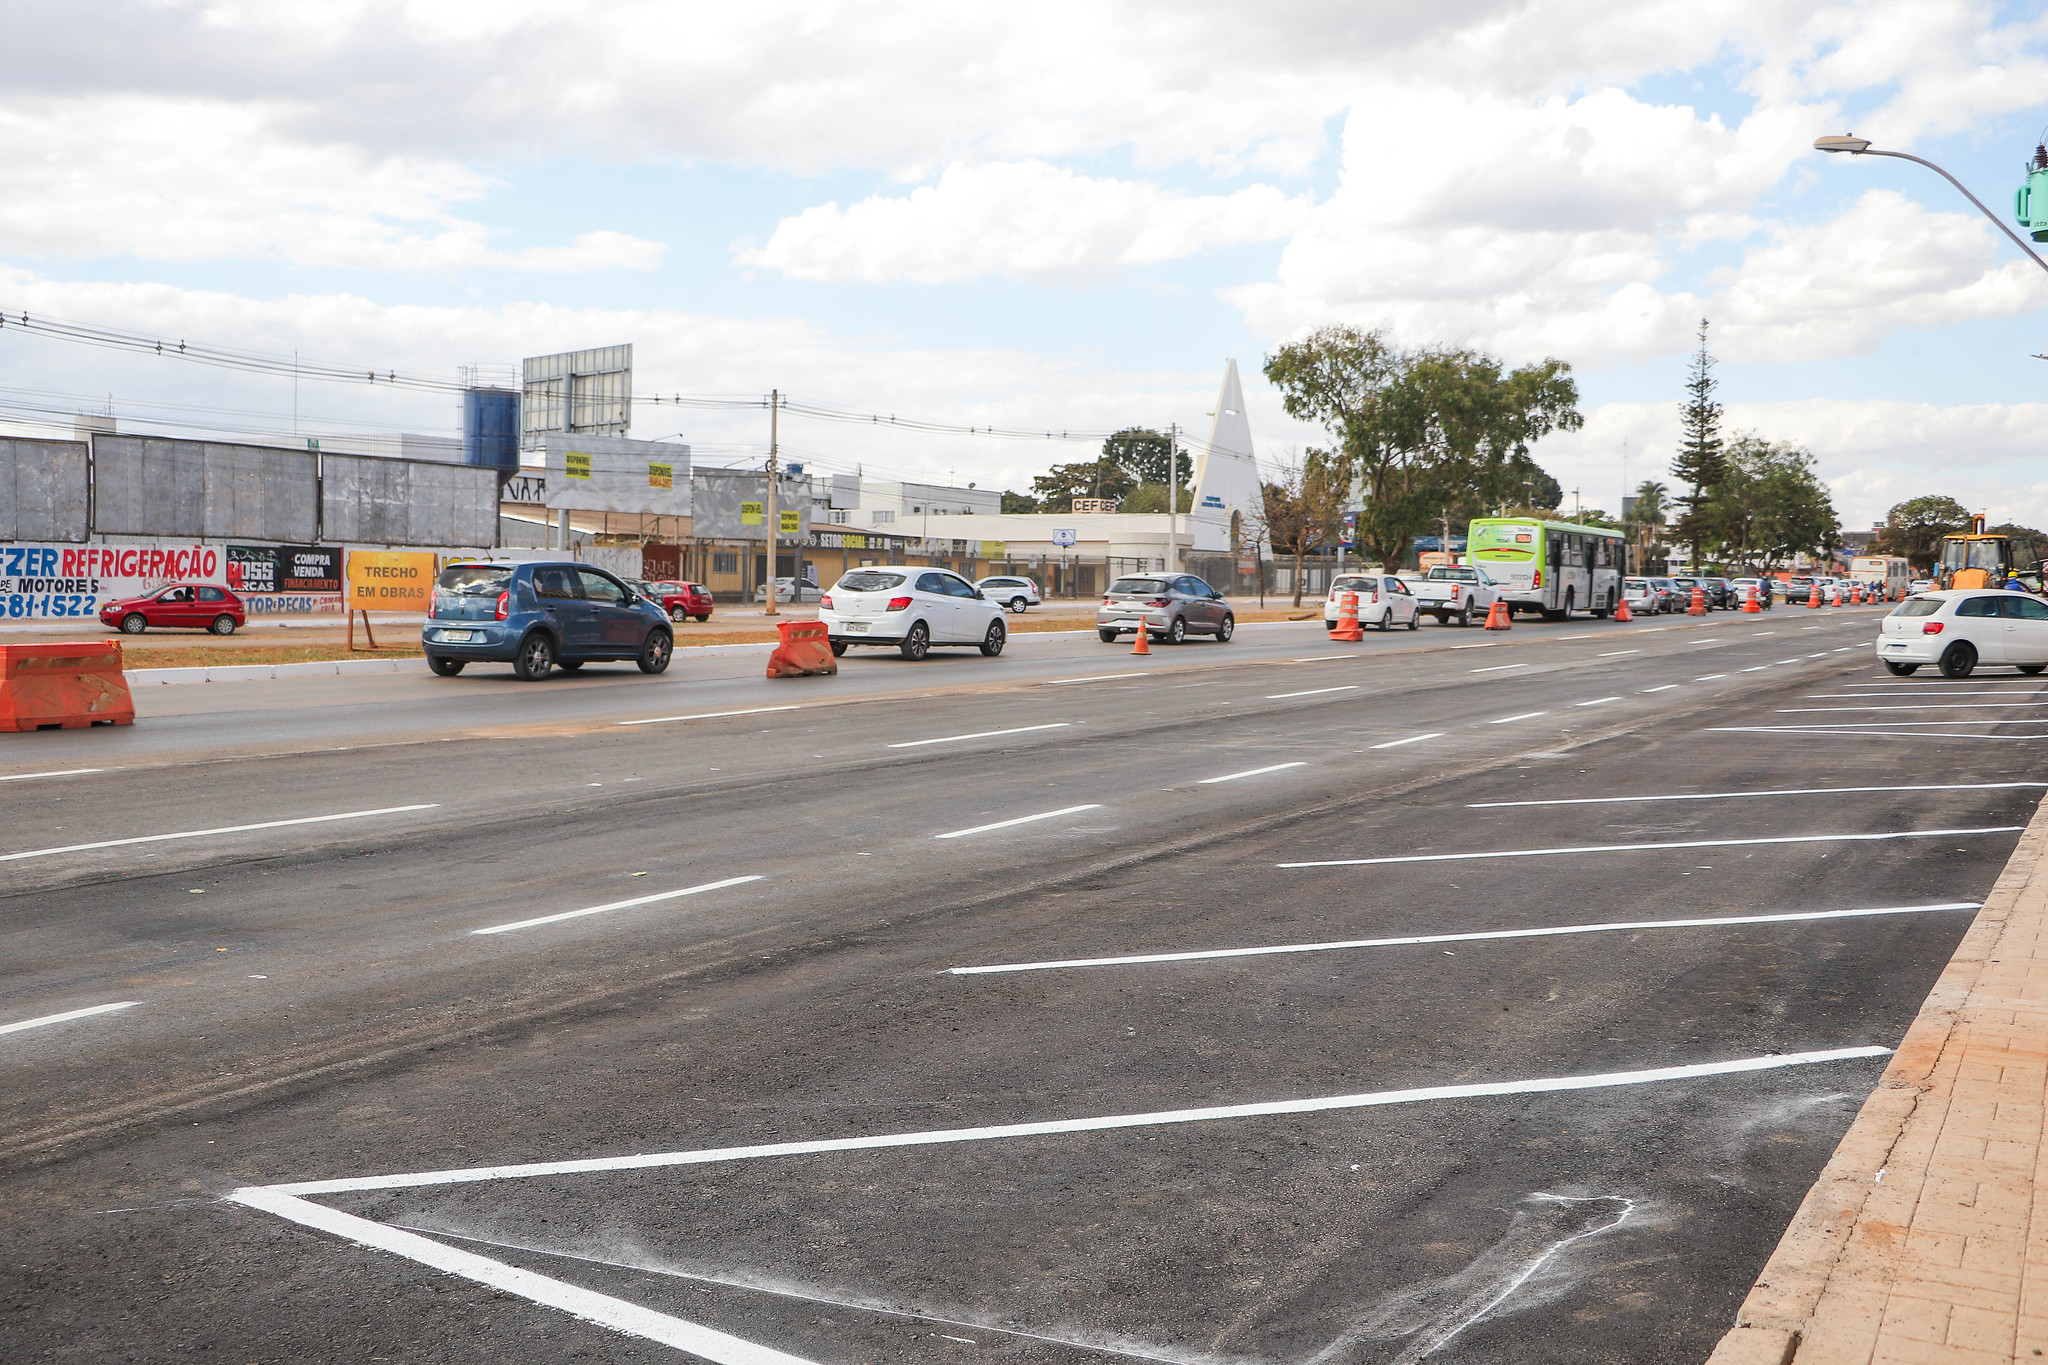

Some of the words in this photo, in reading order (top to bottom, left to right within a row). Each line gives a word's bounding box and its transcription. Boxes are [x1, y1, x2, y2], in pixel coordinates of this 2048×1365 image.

[1074, 500, 1098, 511] CEF
[62, 545, 217, 581] REFRIGERAÇÃO
[294, 554, 331, 566] COMPRA
[293, 566, 325, 578] VENDA
[365, 567, 418, 578] TRECHO
[18, 578, 99, 594] MOTORES
[284, 578, 339, 589] FINANCIAMENTO
[357, 586, 375, 597] EM
[379, 586, 425, 599] OBRAS
